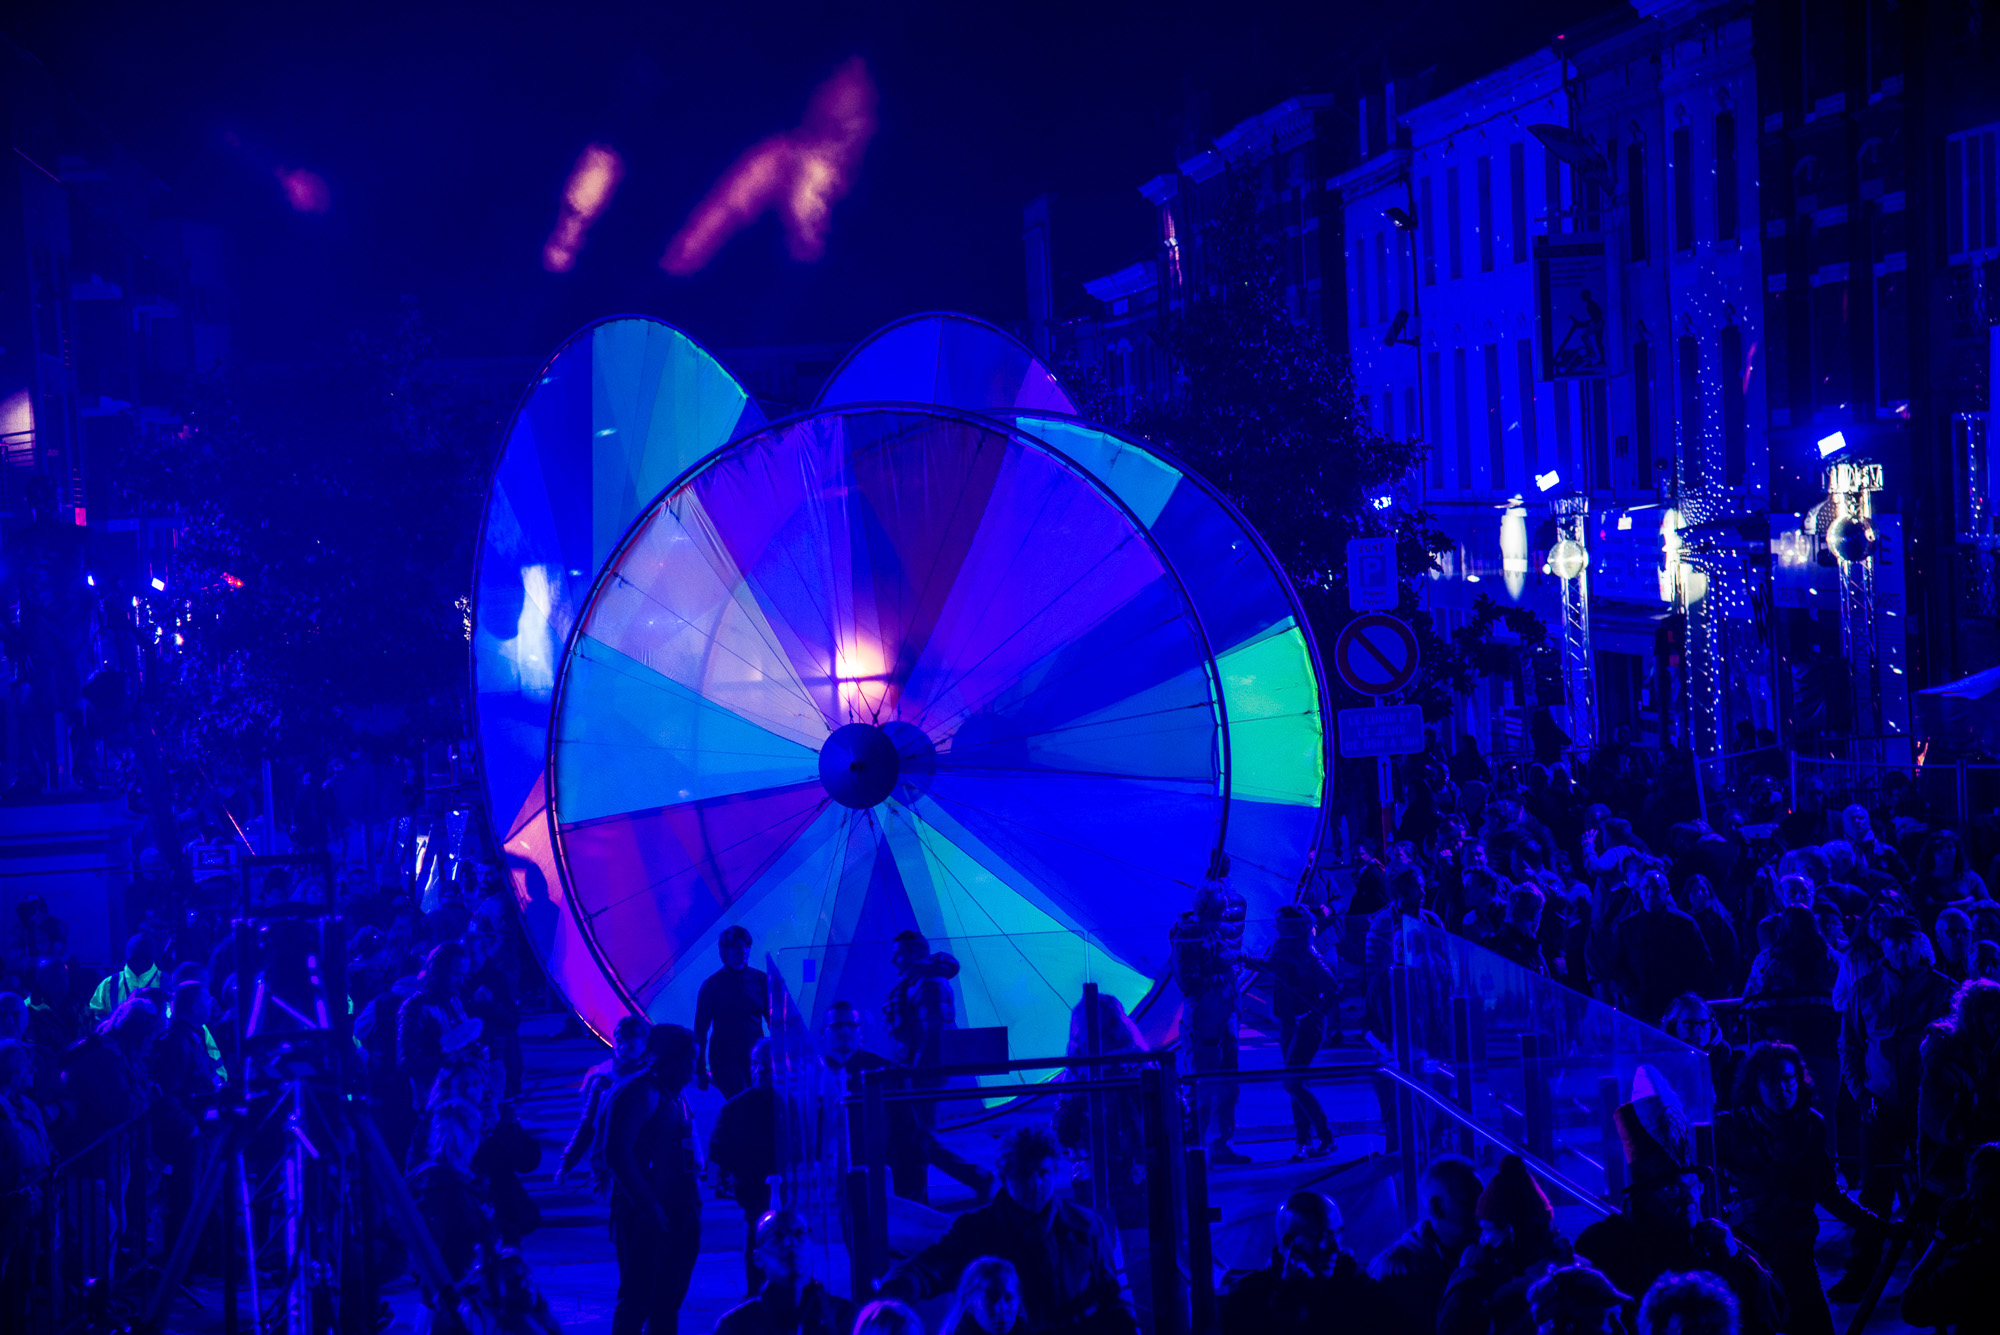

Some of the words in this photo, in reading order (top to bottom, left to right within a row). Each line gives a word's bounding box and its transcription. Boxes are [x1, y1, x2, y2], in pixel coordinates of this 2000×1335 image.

[1358, 543, 1385, 553] ZONE
[1362, 557, 1382, 585] P
[1362, 589, 1386, 597] Rappel
[1362, 598, 1386, 606] Payant
[1348, 715, 1361, 726] LE
[1365, 713, 1396, 725] LUNDI
[1400, 711, 1413, 722] ET
[1357, 727, 1370, 738] LE
[1375, 724, 1406, 737] JEUDI
[1345, 740, 1360, 751] DE
[1363, 738, 1385, 750] 05H
[1389, 737, 1397, 748] A
[1401, 736, 1419, 747] 15H
